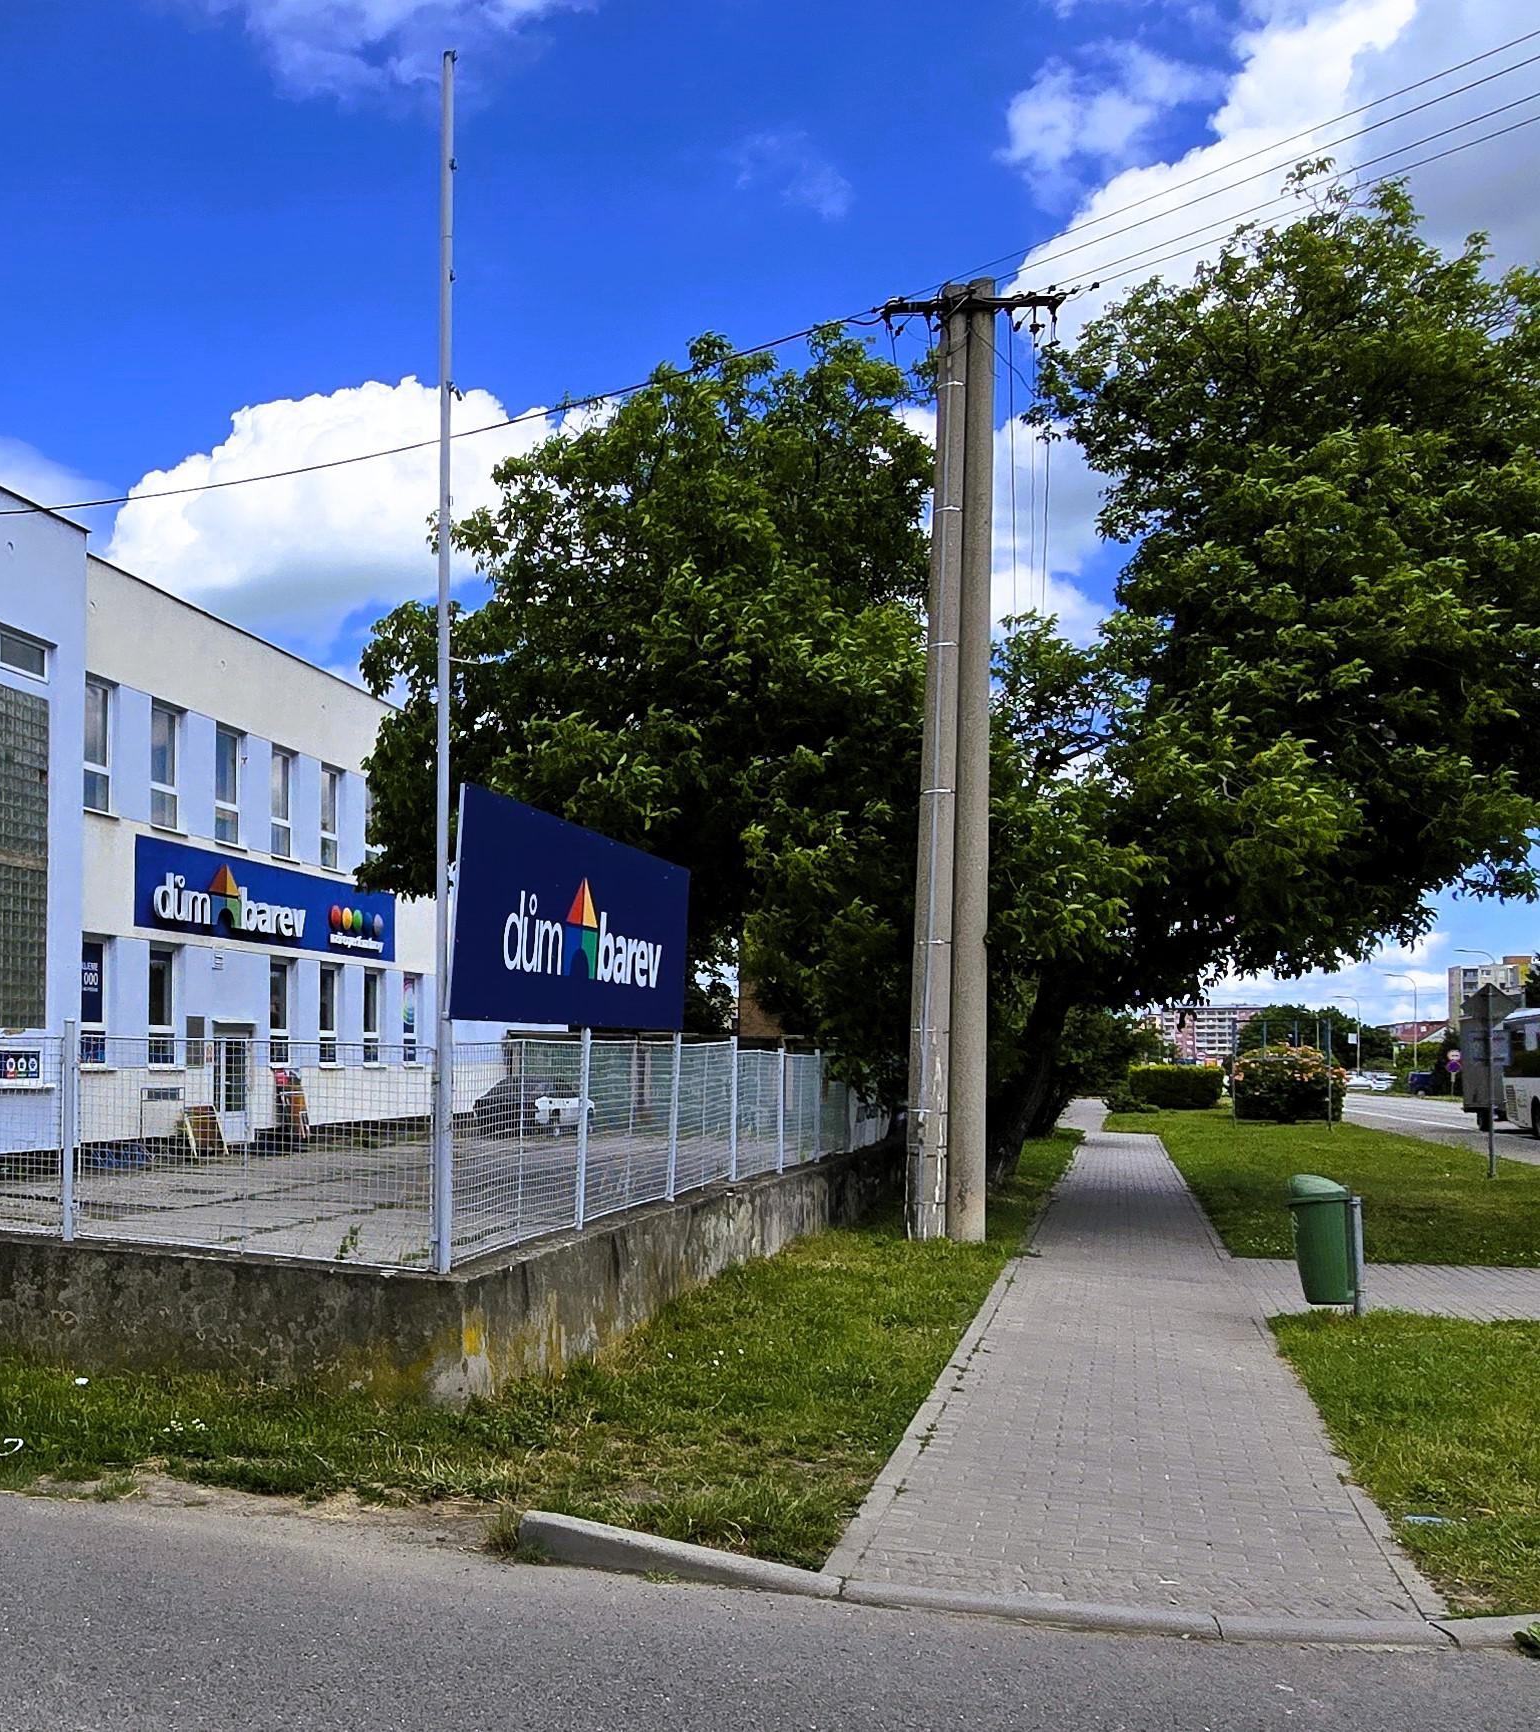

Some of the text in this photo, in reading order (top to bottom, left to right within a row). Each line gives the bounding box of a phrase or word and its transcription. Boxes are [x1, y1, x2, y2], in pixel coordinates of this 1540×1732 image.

[153, 872, 307, 938] dům barev
[503, 890, 663, 988] dům barev
